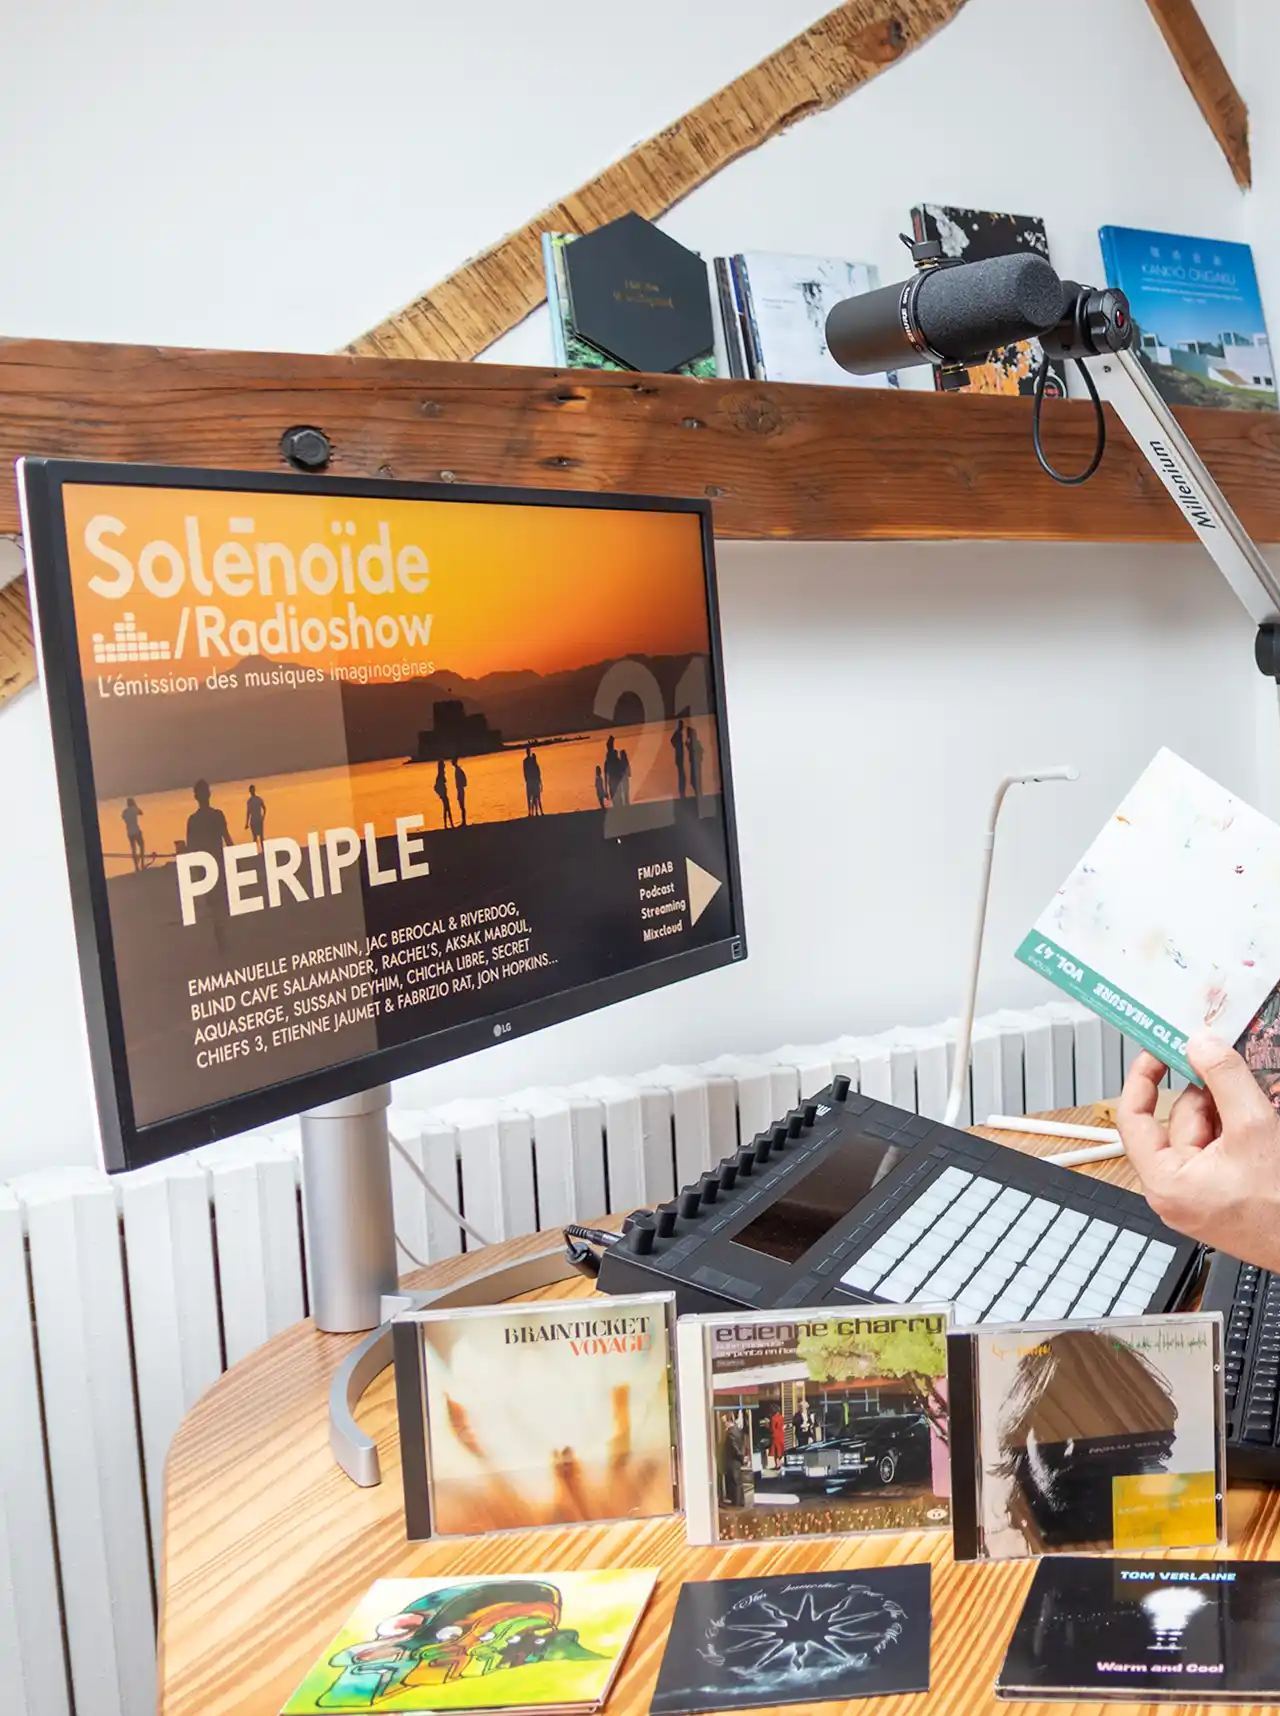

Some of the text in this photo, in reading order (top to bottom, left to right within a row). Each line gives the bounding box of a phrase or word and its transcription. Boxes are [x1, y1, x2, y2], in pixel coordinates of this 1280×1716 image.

[901, 308, 917, 343] SHURE
[1149, 440, 1216, 529] Millenium
[98, 659, 435, 698] L'émission des musiques imaginogènes
[176, 814, 430, 926] PERIPLE
[637, 861, 674, 880] FM/DAB
[640, 881, 675, 900] Podcast
[641, 899, 686, 920] Streaming
[643, 920, 683, 942] Mixcloud
[188, 901, 519, 996] EMMANUELLE PARRENIN, JAC BEROCAL & RIVERDOG,
[1034, 942, 1054, 959] 47
[191, 919, 532, 1020] BLIND CAVE SALAMANDER, RACHEL'S, AKSAK MABOUL,
[1057, 953, 1084, 982] VOL.
[194, 938, 530, 1045] AQUASERGE, SUSSAN DEYHIM, CHICHA LIBRE, SECRET
[196, 1039, 250, 1068] CHIEFS
[255, 1036, 267, 1052] 3,
[273, 1016, 331, 1047] ETIENNE
[333, 1001, 380, 1032] JAUMET
[385, 999, 394, 1013] &
[397, 982, 449, 1009] FABRIZIO
[452, 975, 475, 995] RAT,
[477, 967, 500, 989] JON
[1093, 982, 1154, 1030] MEASURE
[502, 1022, 512, 1034] LG
[1153, 1024, 1171, 1045] TO
[505, 1316, 650, 1344] BRAINTICKET
[715, 1316, 943, 1342] etienne charry
[569, 1335, 653, 1356] VOYAGE
[1120, 1571, 1237, 1581] TOM VERLAINE
[1097, 1661, 1224, 1673] Warm and Cool
